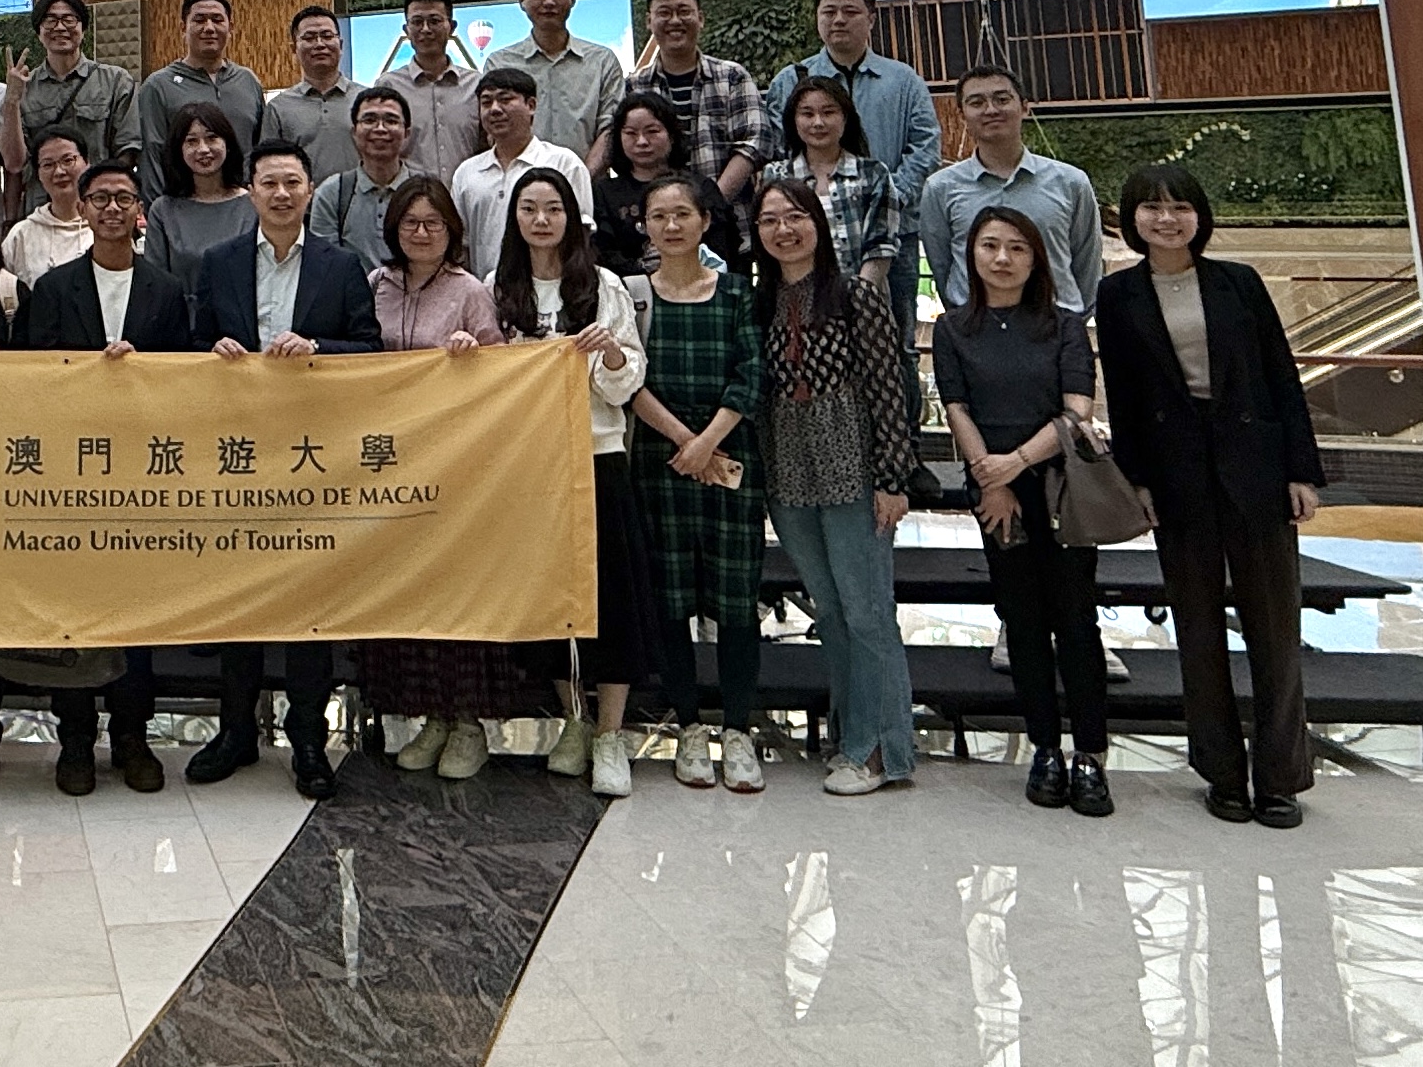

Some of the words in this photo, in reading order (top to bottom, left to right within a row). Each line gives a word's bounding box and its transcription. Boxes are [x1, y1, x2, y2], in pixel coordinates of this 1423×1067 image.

[4, 433, 398, 476] 澳門旅遊大學
[4, 489, 170, 508] UNIVERSIDADE
[178, 489, 206, 507] DE
[211, 488, 315, 508] TURISMO
[323, 487, 351, 505] DE
[359, 484, 440, 505] MACAU
[3, 529, 81, 551] Macao
[90, 528, 207, 558] University
[215, 529, 239, 550] of
[244, 528, 336, 551] Tourism
